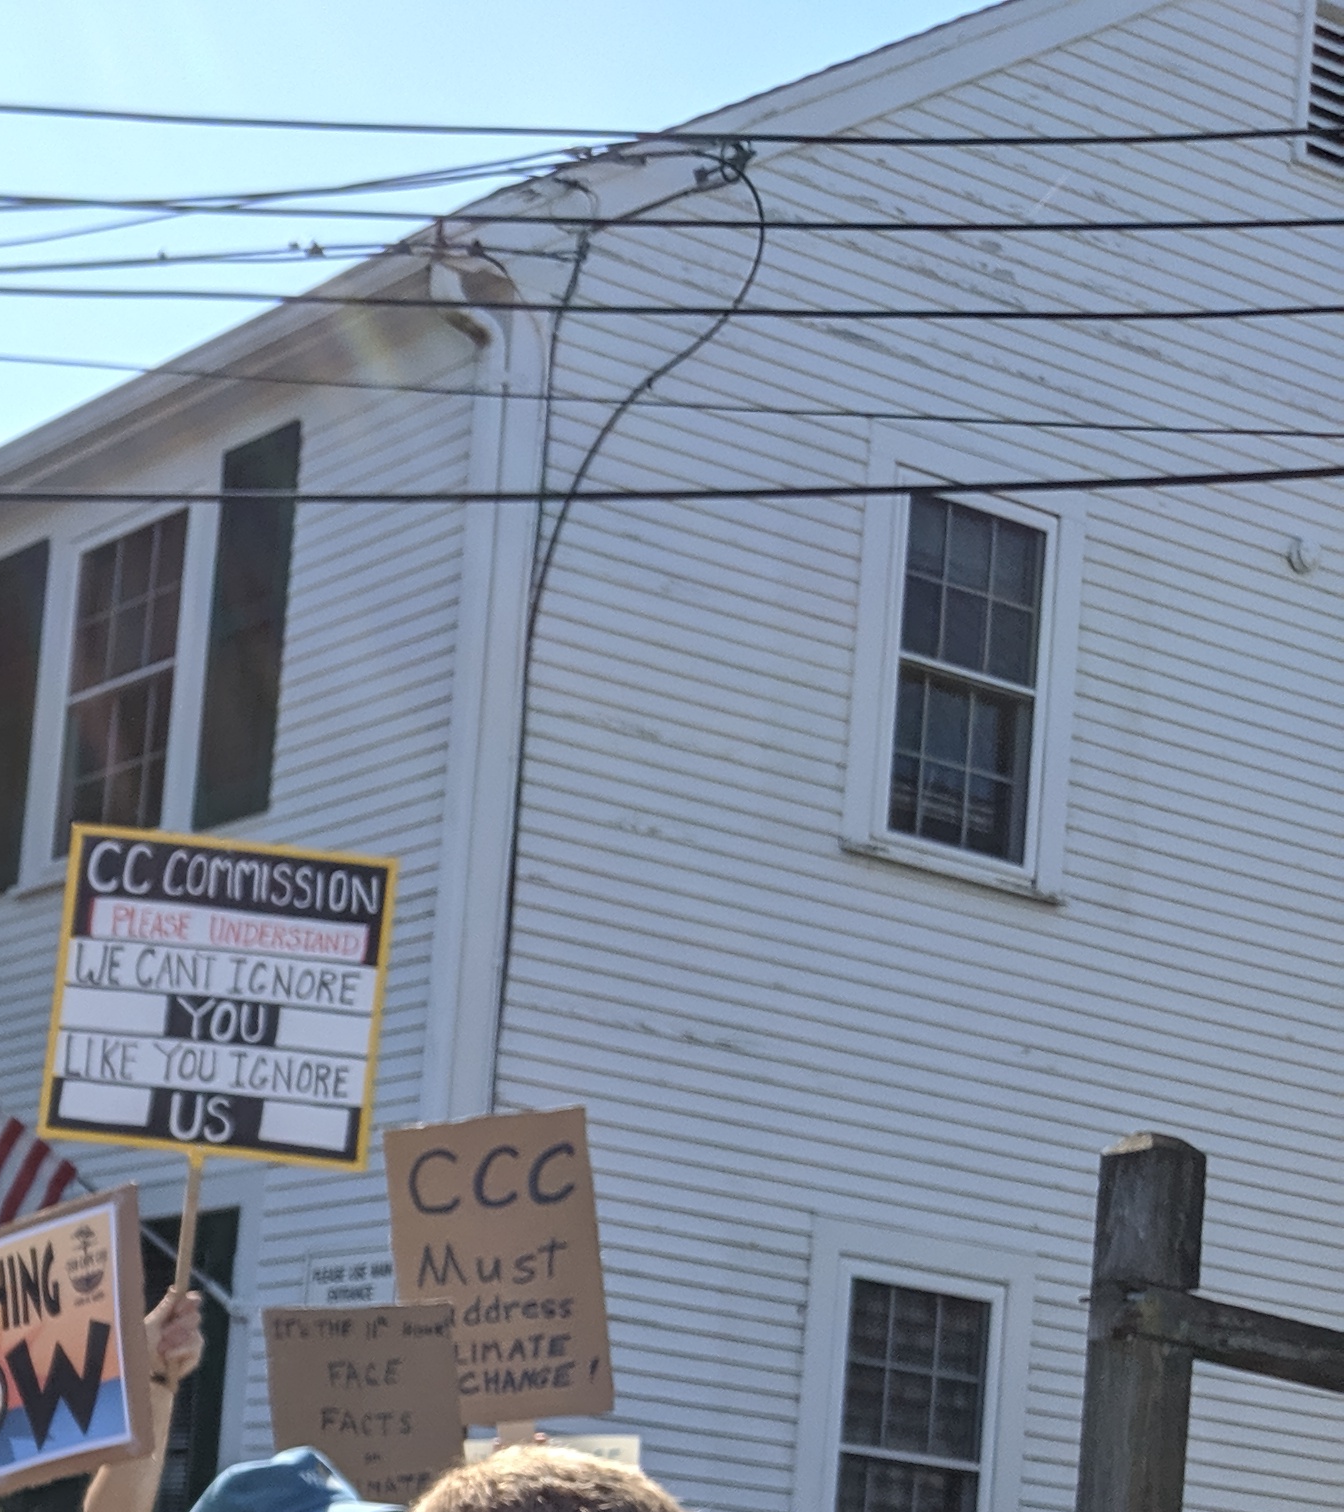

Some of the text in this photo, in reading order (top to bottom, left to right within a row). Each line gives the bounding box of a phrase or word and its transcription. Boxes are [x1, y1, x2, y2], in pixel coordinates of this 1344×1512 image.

[87, 840, 380, 915] CC COMMISSION
[111, 904, 361, 955] PLEASE UNDERSTAND
[74, 942, 123, 986] WE
[229, 956, 363, 1006] IGNORE
[176, 996, 265, 1043] YOU
[64, 1034, 350, 1098] LIKE YOU IGNORE
[168, 1090, 234, 1142] US
[409, 1141, 576, 1215] CCC
[416, 1238, 567, 1289] Must
[326, 1355, 405, 1387] FACE
[454, 1332, 572, 1366] LIMATE
[459, 1360, 576, 1396] CHANGE
[320, 1405, 413, 1437] FACTS
